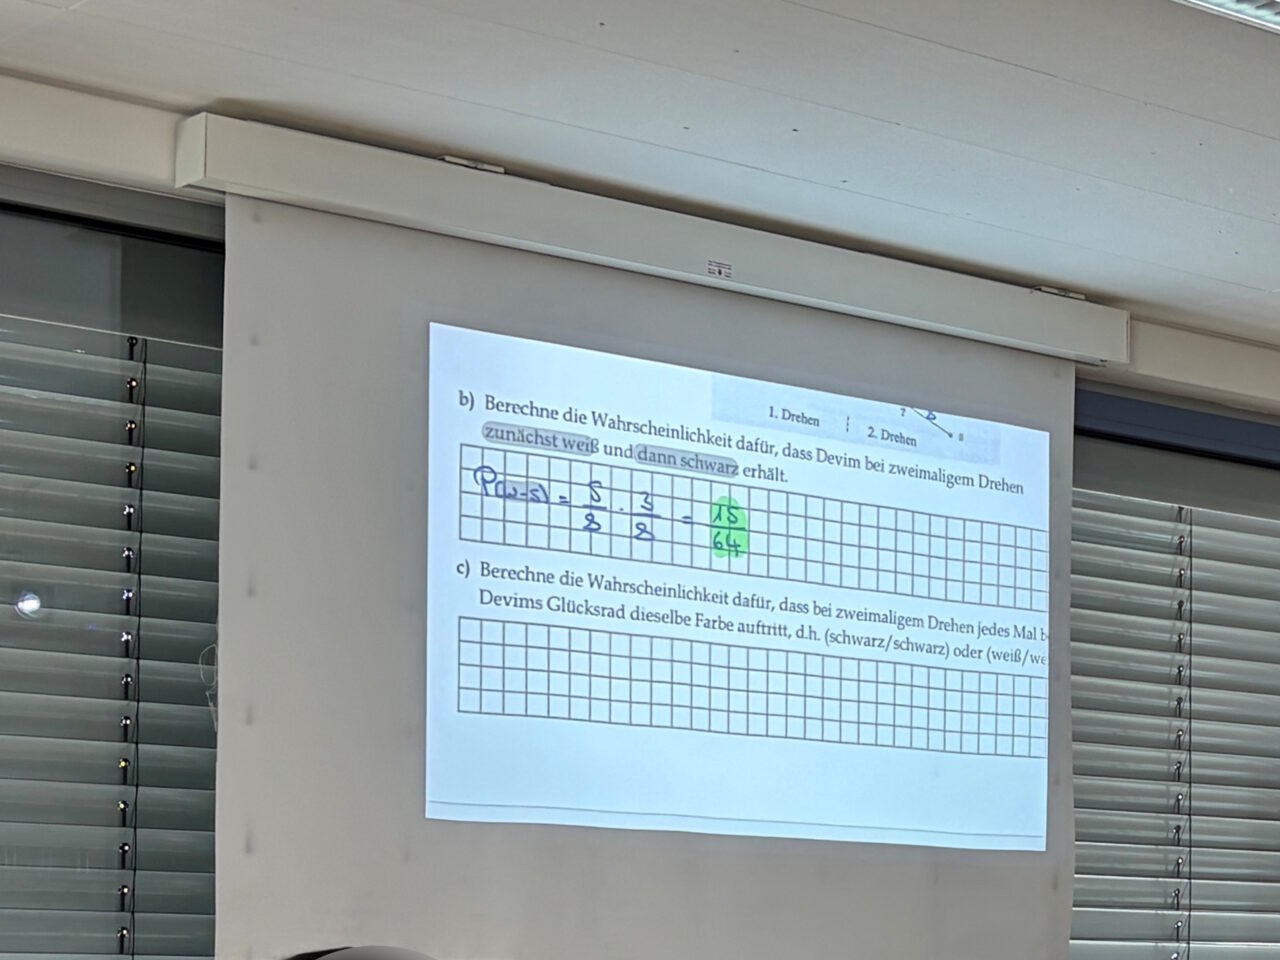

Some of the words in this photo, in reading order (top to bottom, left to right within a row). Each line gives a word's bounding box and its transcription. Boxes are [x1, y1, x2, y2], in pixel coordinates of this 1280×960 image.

[458, 390, 475, 411] b)
[485, 394, 559, 420] Berechne
[562, 406, 588, 425] die
[591, 410, 733, 449] Wahrscheinlichkeit
[736, 436, 779, 457] dafür,
[782, 443, 813, 462] dass
[816, 448, 861, 470] Devim
[864, 452, 886, 474] bei
[888, 462, 975, 489] zweimaligem
[978, 474, 1025, 495] Drehen
[768, 406, 779, 419] 1.
[781, 408, 820, 427] Drehen
[867, 426, 879, 439] 2.
[880, 429, 917, 447] Drehen
[484, 426, 558, 448] zunächst
[562, 436, 600, 454] weiß
[603, 443, 634, 460] und
[637, 445, 677, 466] dann
[680, 453, 740, 477] schwarz
[742, 464, 789, 484] erhält.
[456, 560, 471, 579] c)
[479, 562, 555, 584] Berechne
[559, 571, 584, 588] die
[587, 573, 730, 606] Wahrscheinlichkeit
[732, 591, 776, 613] dafür,
[779, 597, 810, 614] dass
[812, 600, 833, 618] bei
[835, 606, 925, 630] zweimaligem
[927, 615, 975, 635] Drehen
[977, 620, 1010, 640] jedes
[1013, 624, 1037, 641] Mal
[479, 588, 544, 610] Devims
[546, 596, 626, 620] Glücksrad
[629, 605, 692, 627] dieselbe
[695, 613, 734, 633] Farbe
[737, 618, 792, 639] auftritt,
[795, 624, 821, 642] d.h.
[824, 627, 950, 660] (schwarz/schwarz)
[953, 643, 984, 660] oder
